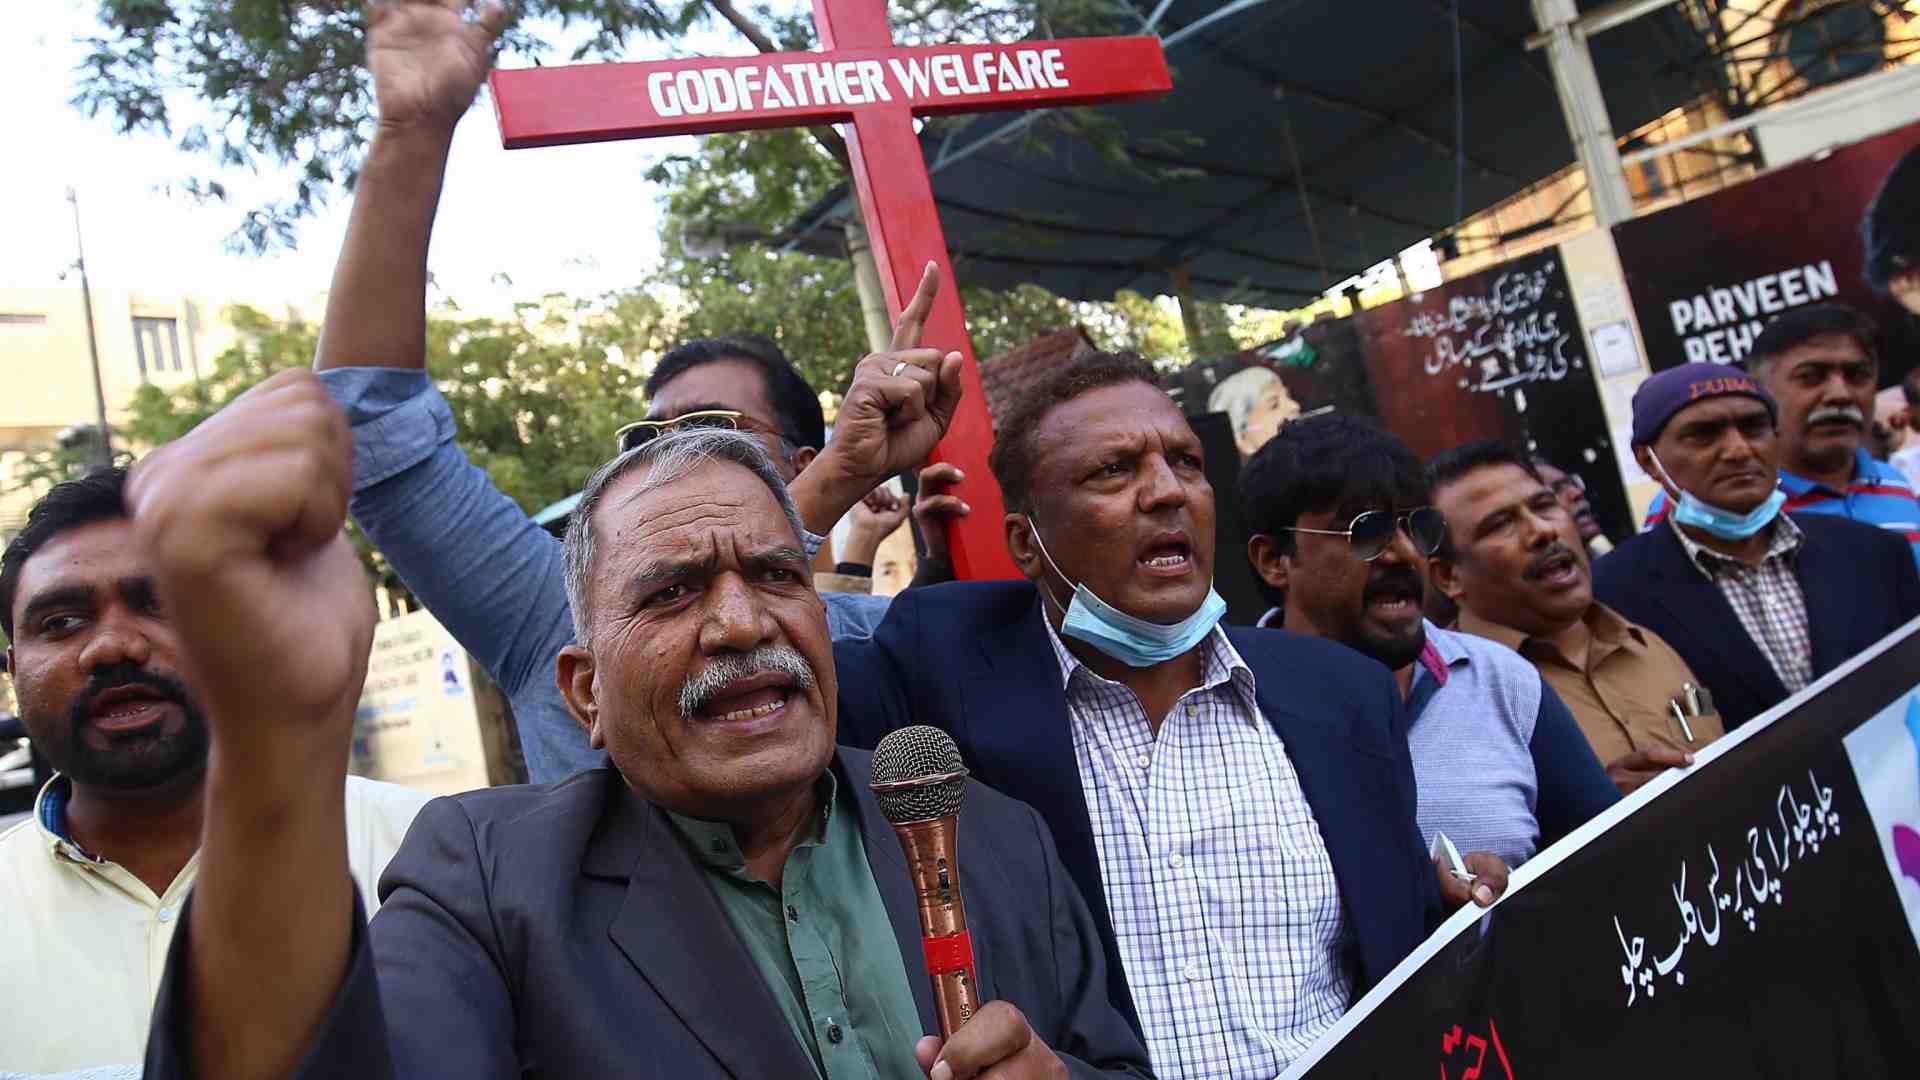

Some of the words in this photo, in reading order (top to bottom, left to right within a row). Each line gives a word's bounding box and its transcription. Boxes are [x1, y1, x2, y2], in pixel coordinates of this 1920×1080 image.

[648, 59, 892, 117] GODFATHER
[890, 48, 1070, 100] WELFARE
[1669, 260, 1839, 336] PARVEEN
[1745, 783, 1791, 905] کراچی
[1786, 784, 1819, 860] چلو
[1808, 768, 1841, 841] چلو
[1652, 859, 1698, 986] کلب
[1696, 842, 1756, 947] پریس
[1613, 914, 1655, 1008] چلو
